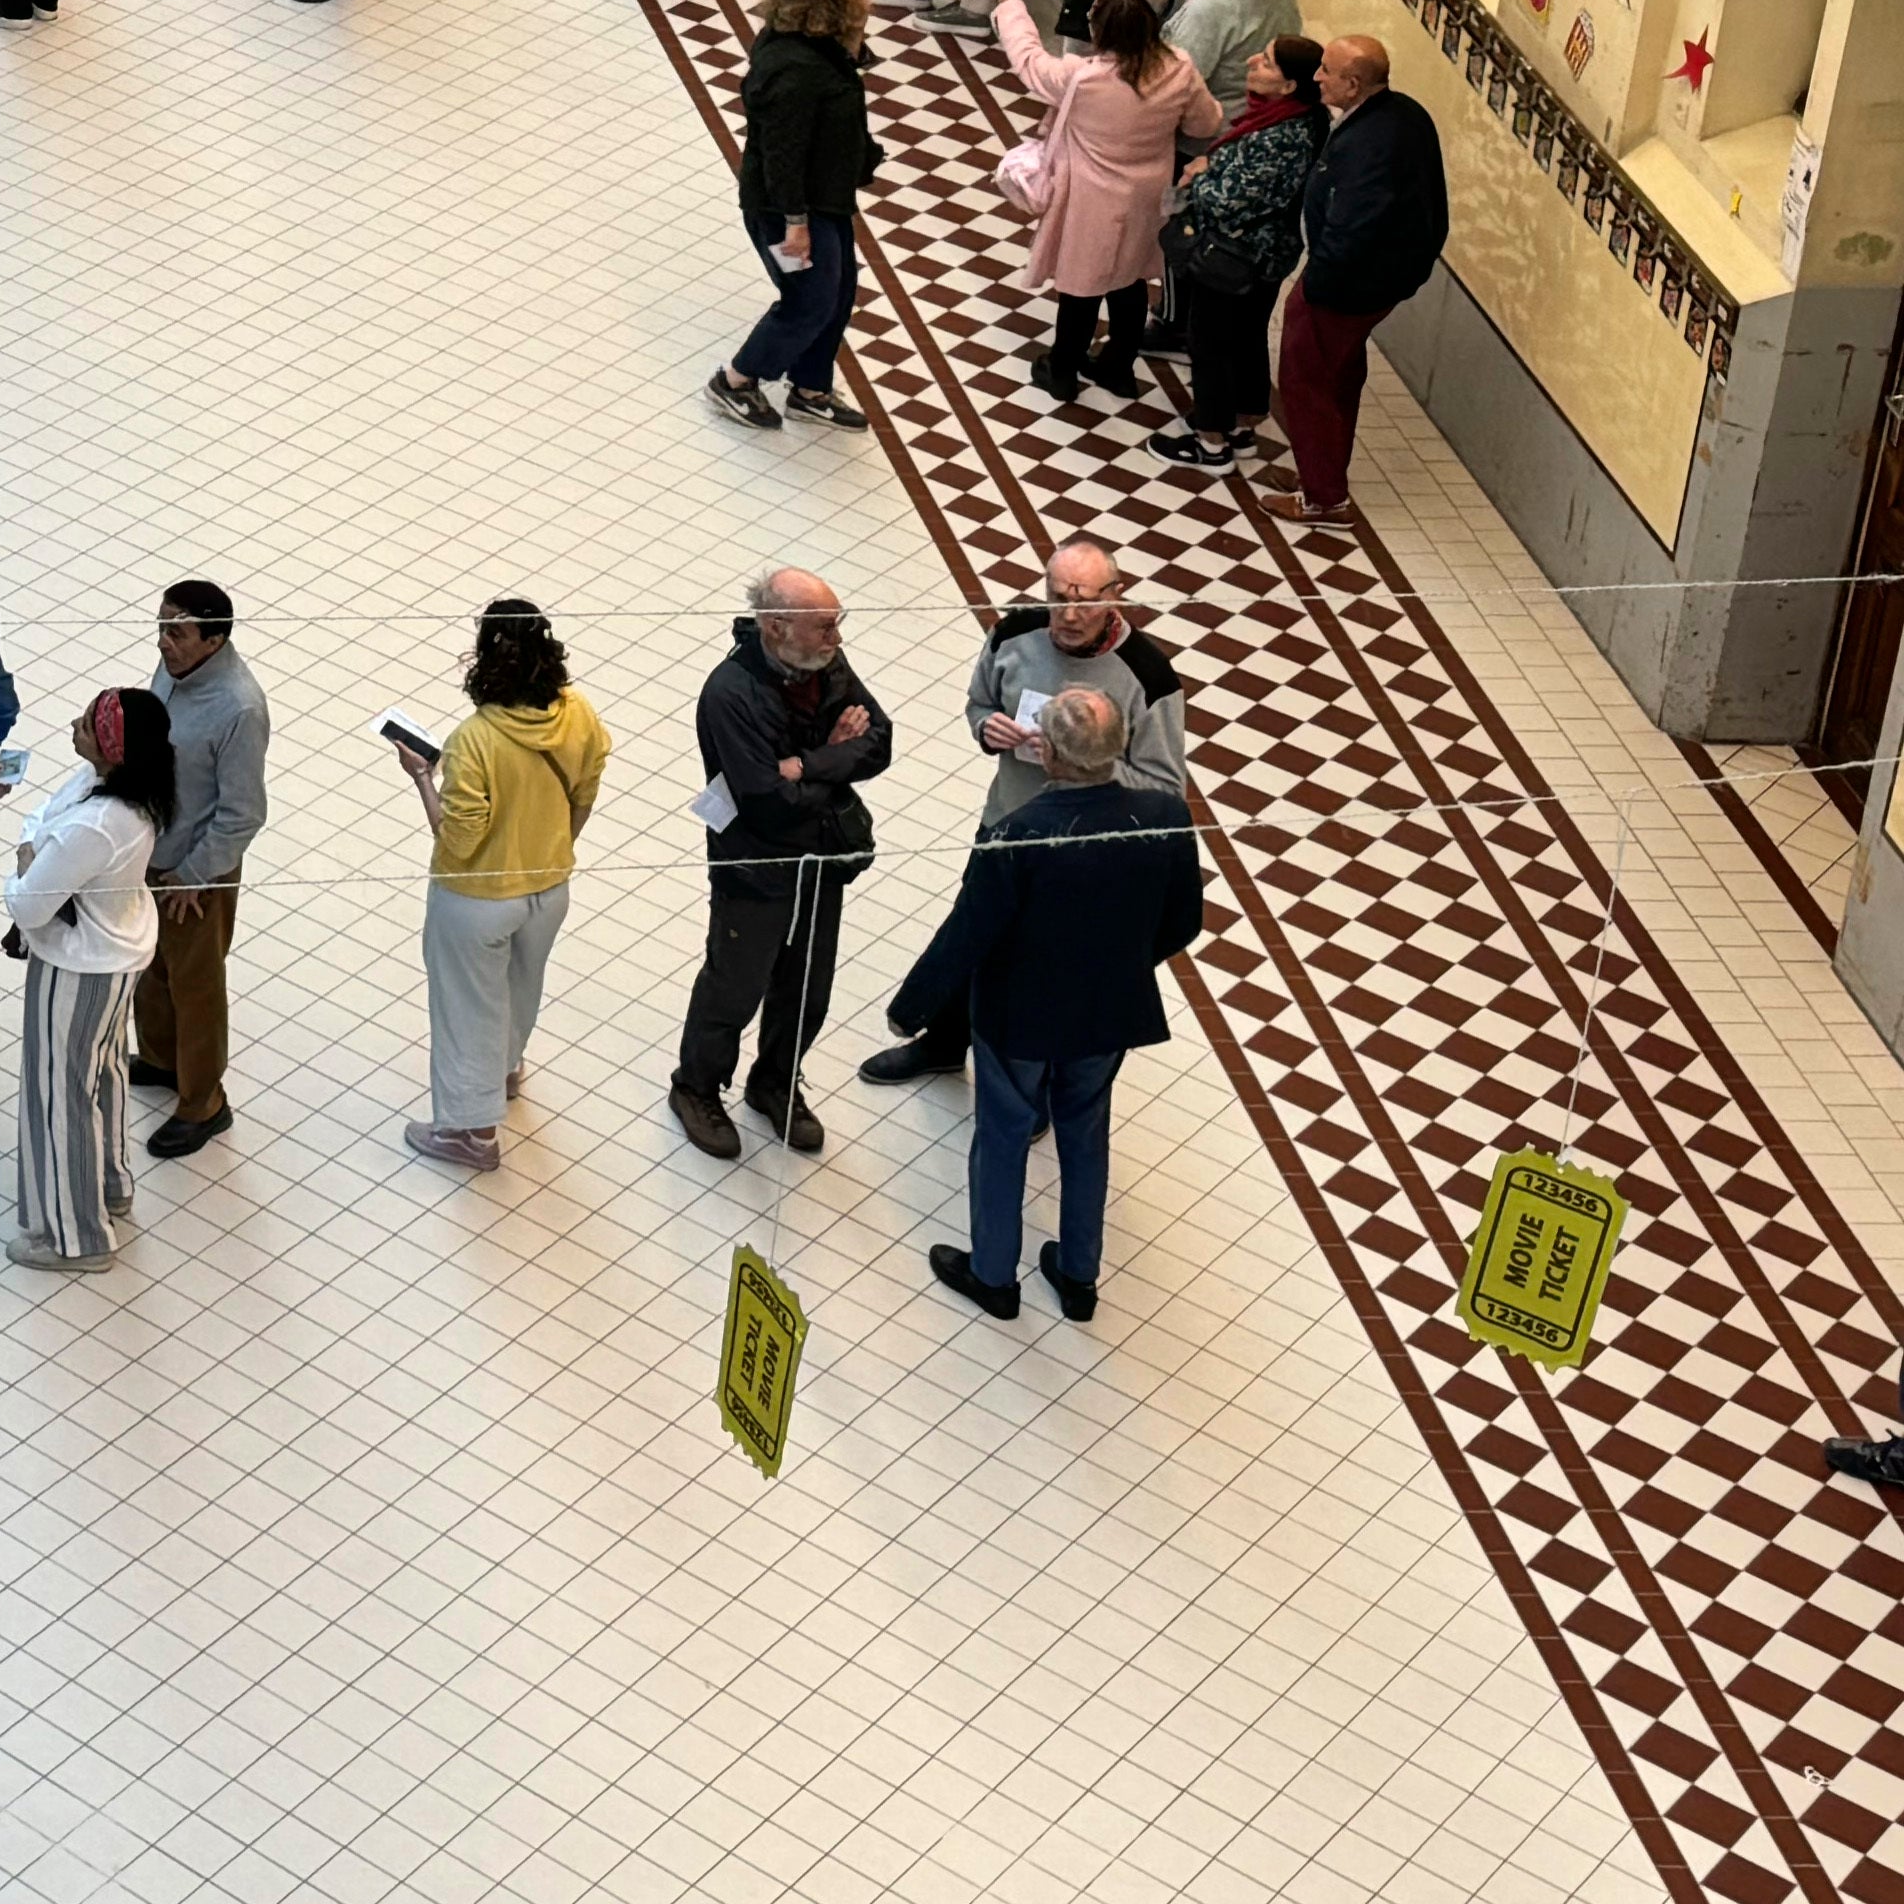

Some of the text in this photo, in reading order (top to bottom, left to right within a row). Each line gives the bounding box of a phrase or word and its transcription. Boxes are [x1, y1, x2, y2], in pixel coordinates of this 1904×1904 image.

[1523, 1173, 1598, 1214] 123456
[1504, 1213, 1545, 1289] MOVIE
[1539, 1225, 1580, 1302] TICKET
[741, 1313, 763, 1392] TICKET
[1487, 1302, 1558, 1344] 123456
[758, 1334, 781, 1412] MOVIE
